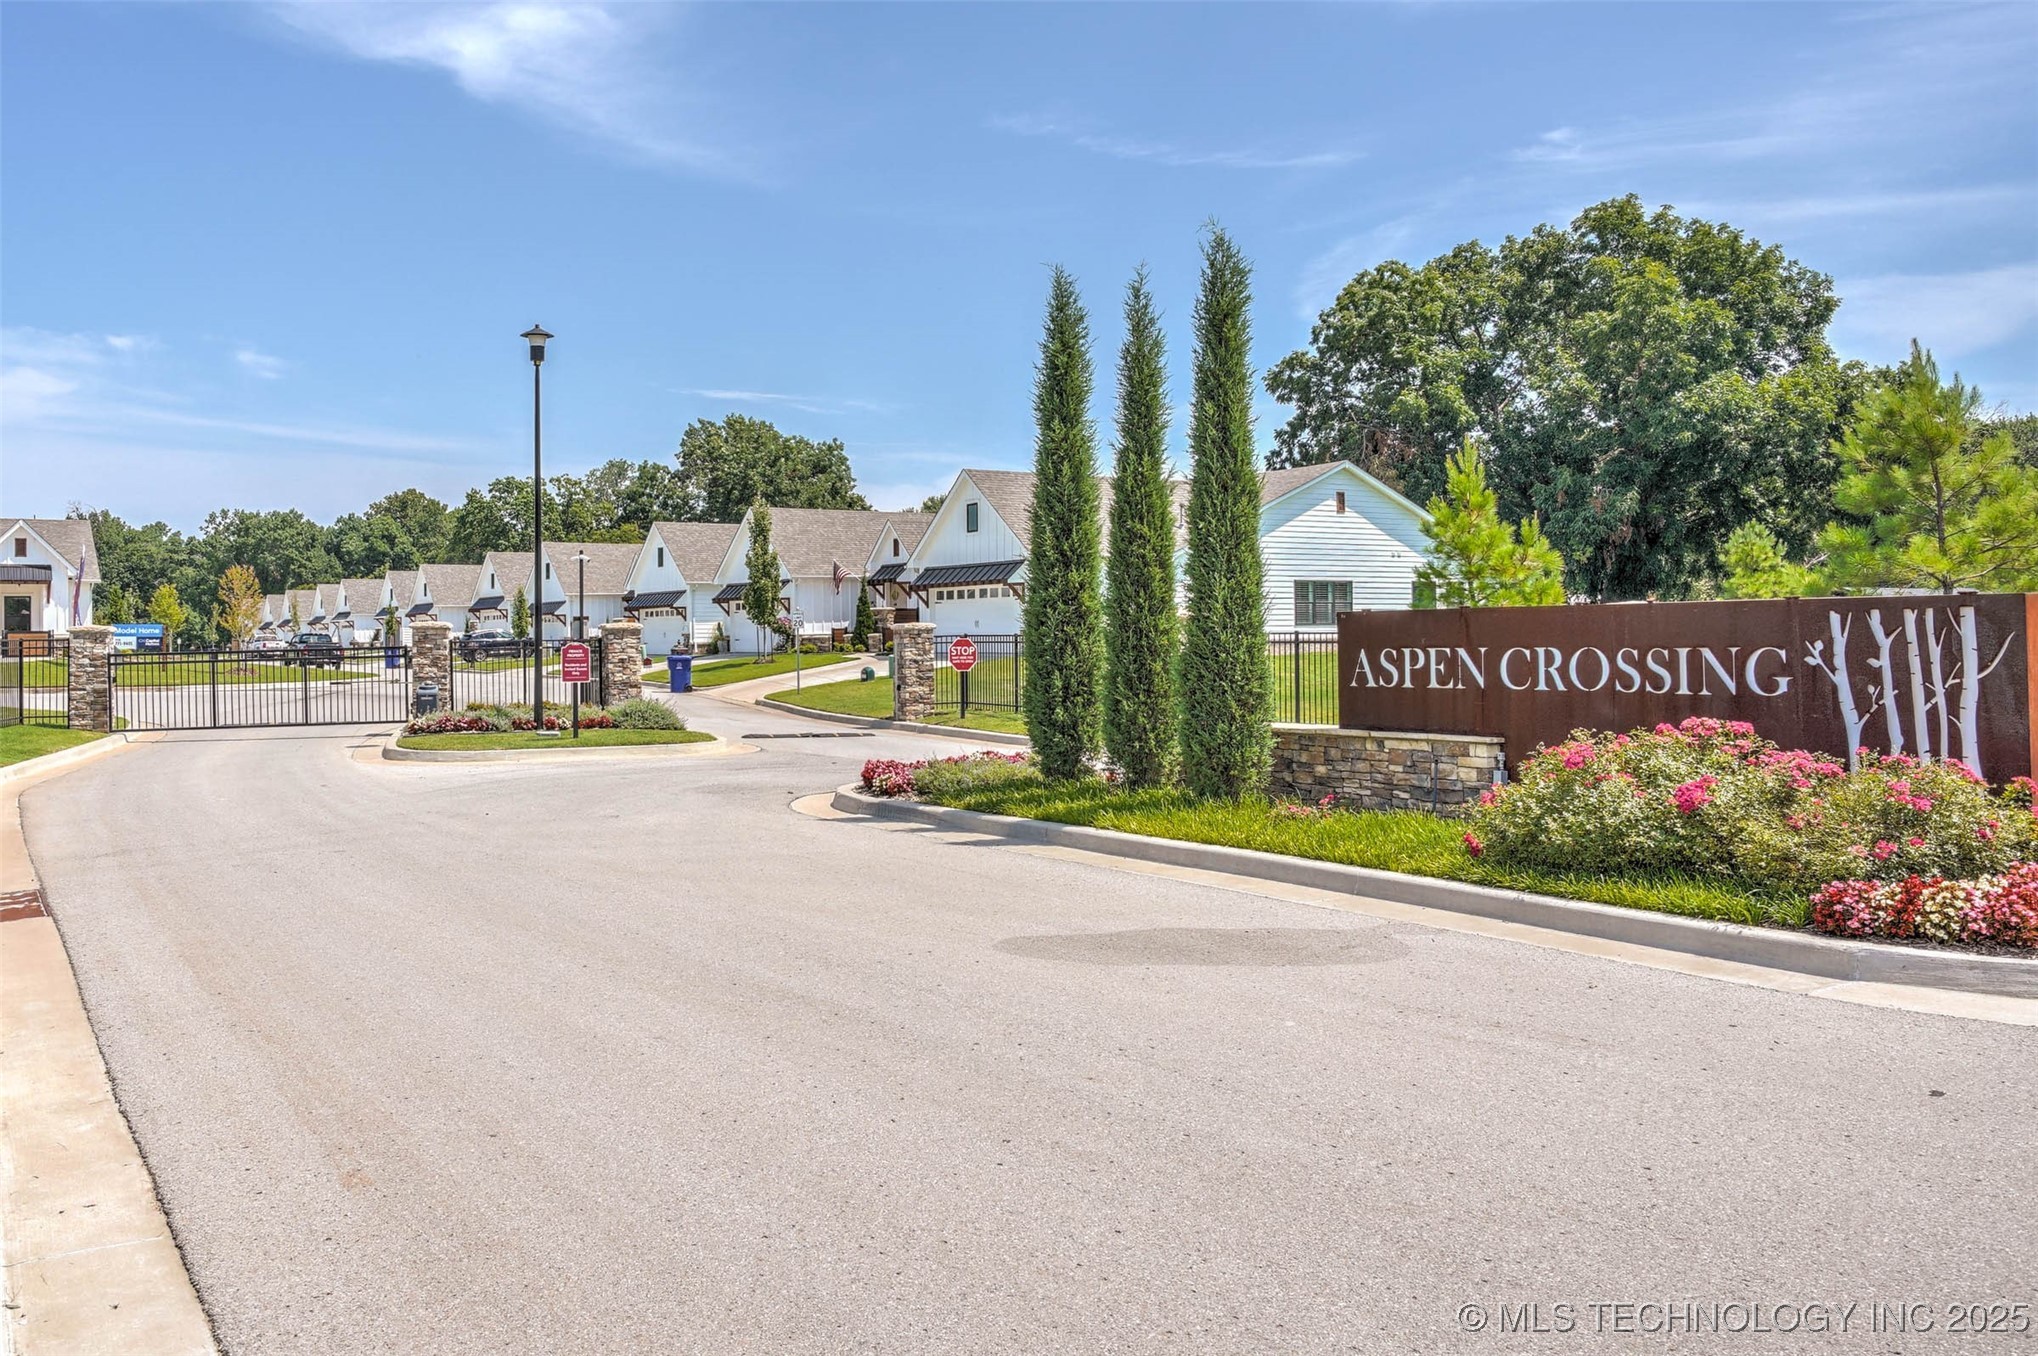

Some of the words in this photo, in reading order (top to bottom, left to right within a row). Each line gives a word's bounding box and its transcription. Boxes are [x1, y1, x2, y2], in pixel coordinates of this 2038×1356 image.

[951, 646, 975, 655] STOP
[1349, 647, 1489, 689] ASPEN
[1499, 646, 1795, 697] CROSSING
